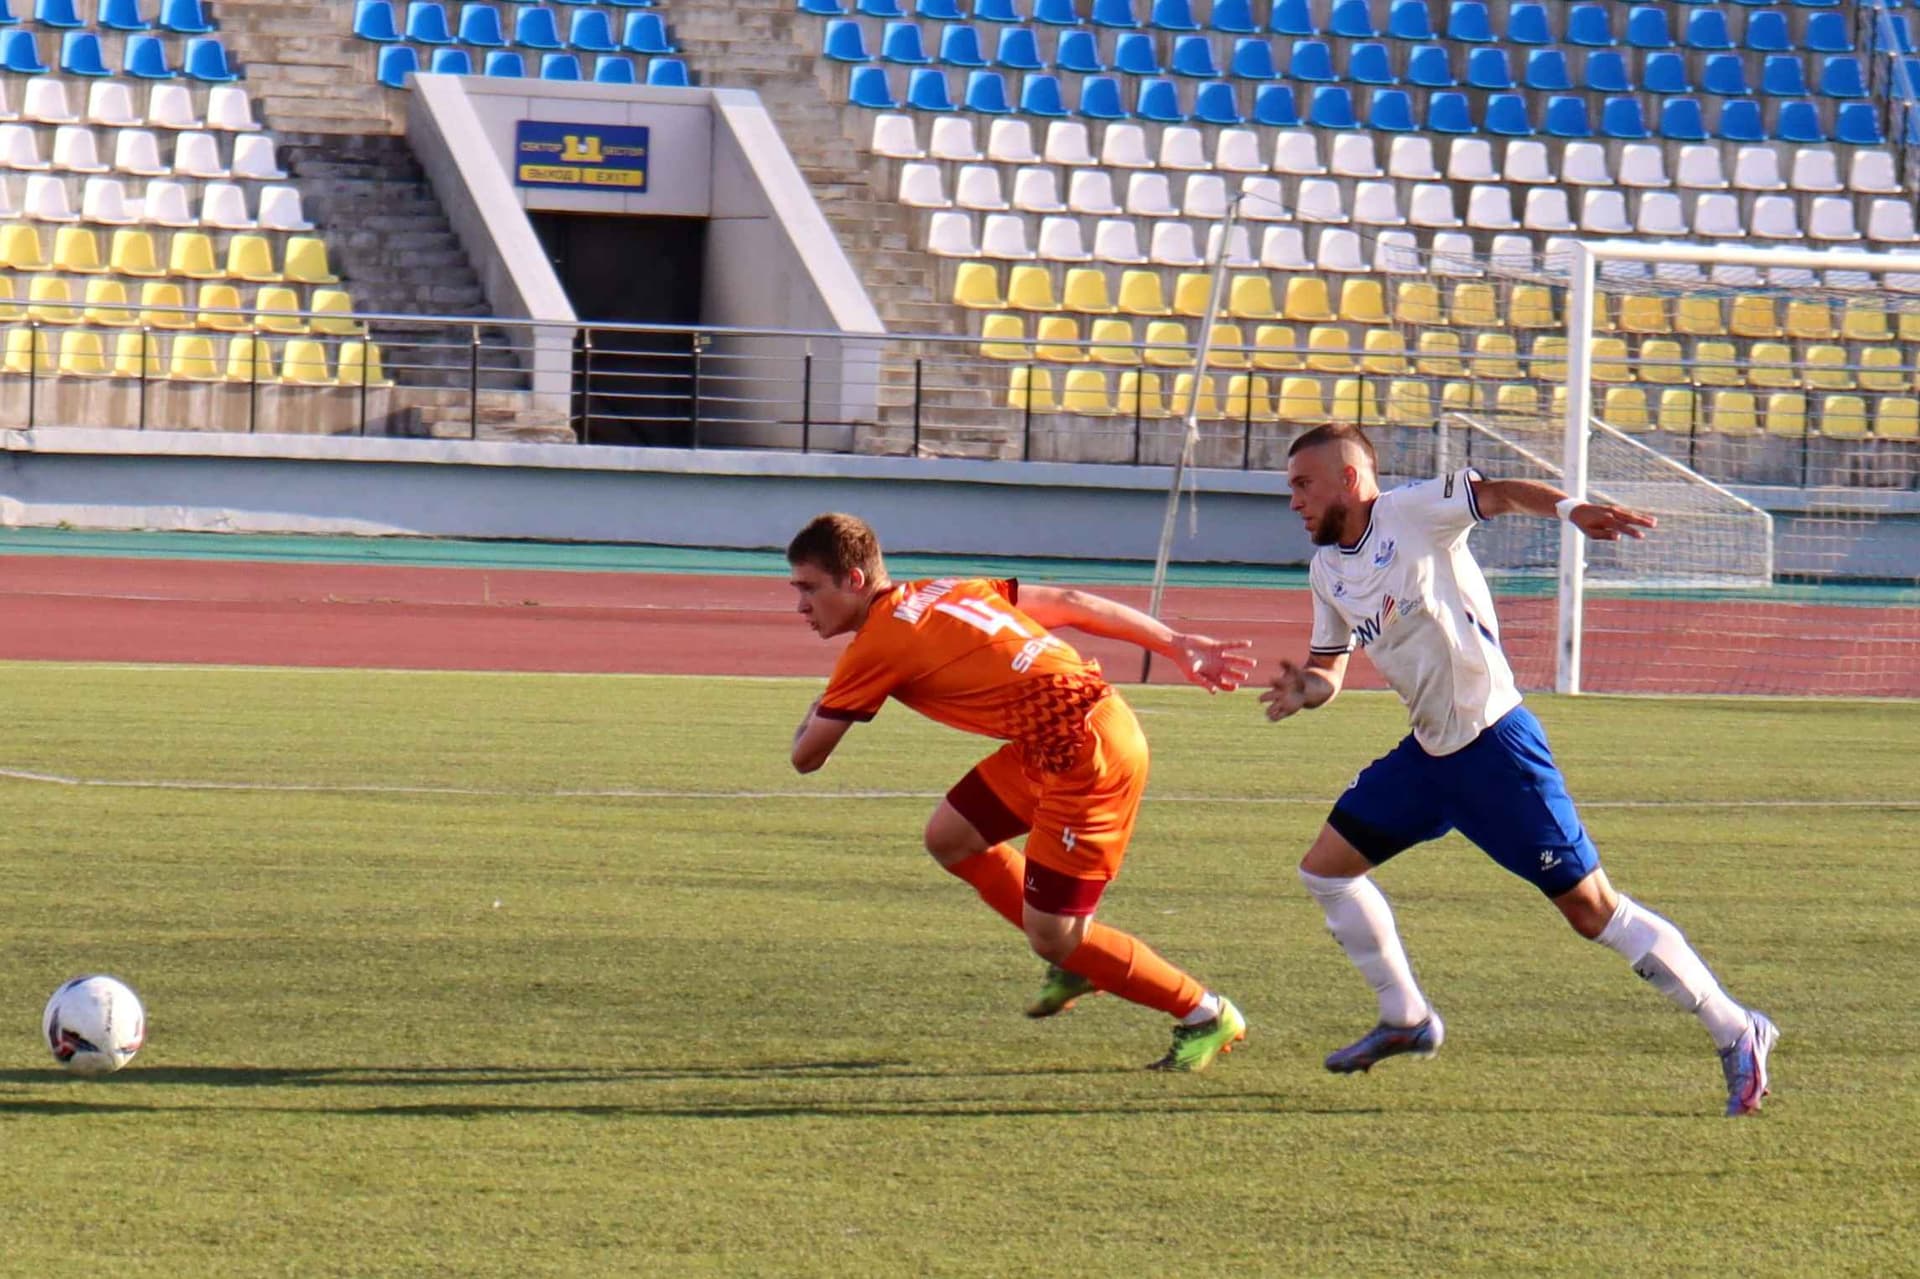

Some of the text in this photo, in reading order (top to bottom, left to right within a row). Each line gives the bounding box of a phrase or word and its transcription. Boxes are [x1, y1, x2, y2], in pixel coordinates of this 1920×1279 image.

[597, 172, 630, 183] EXIT
[934, 597, 1032, 636] 4
[1062, 826, 1076, 852] 4
